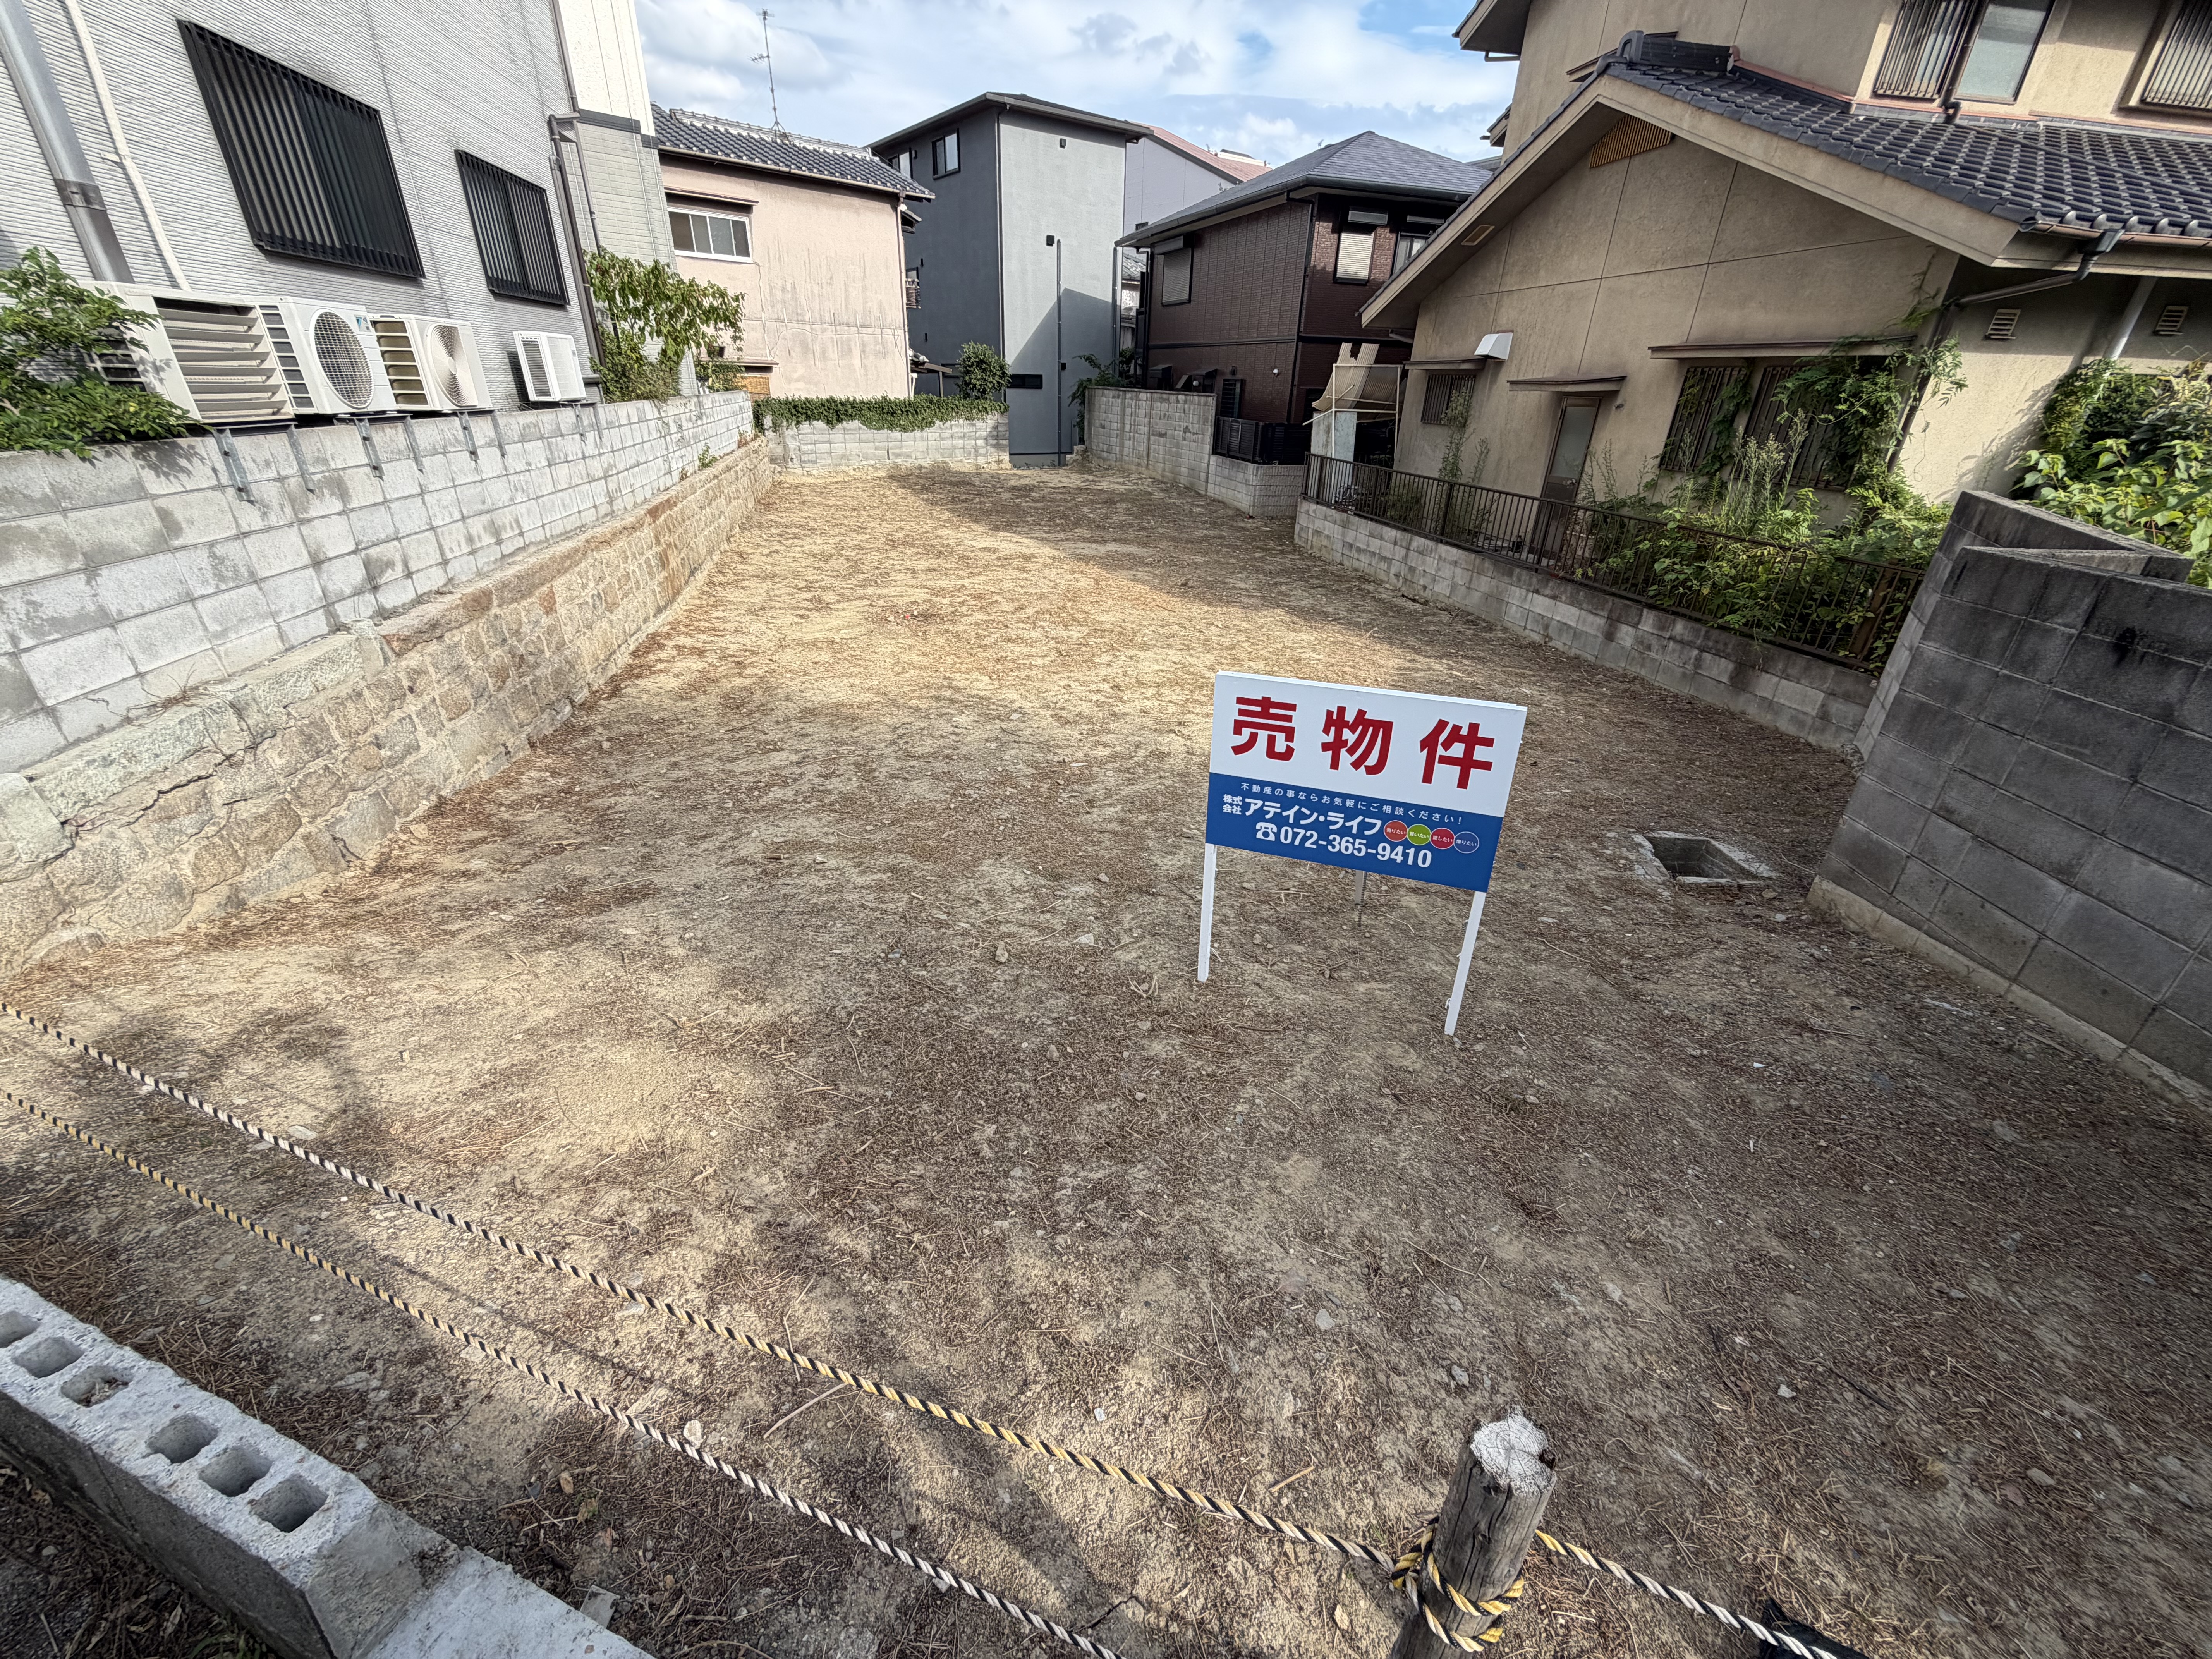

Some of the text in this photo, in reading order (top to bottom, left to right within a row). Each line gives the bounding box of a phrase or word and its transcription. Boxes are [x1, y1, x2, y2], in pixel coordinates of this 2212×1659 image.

[1231, 696, 1495, 790] 売物件
[1223, 794, 1242, 805] 株式
[1223, 804, 1242, 814] 会社
[1245, 798, 1382, 835] アテイン・ライフ
[1280, 826, 1432, 867] 072-365-9410
